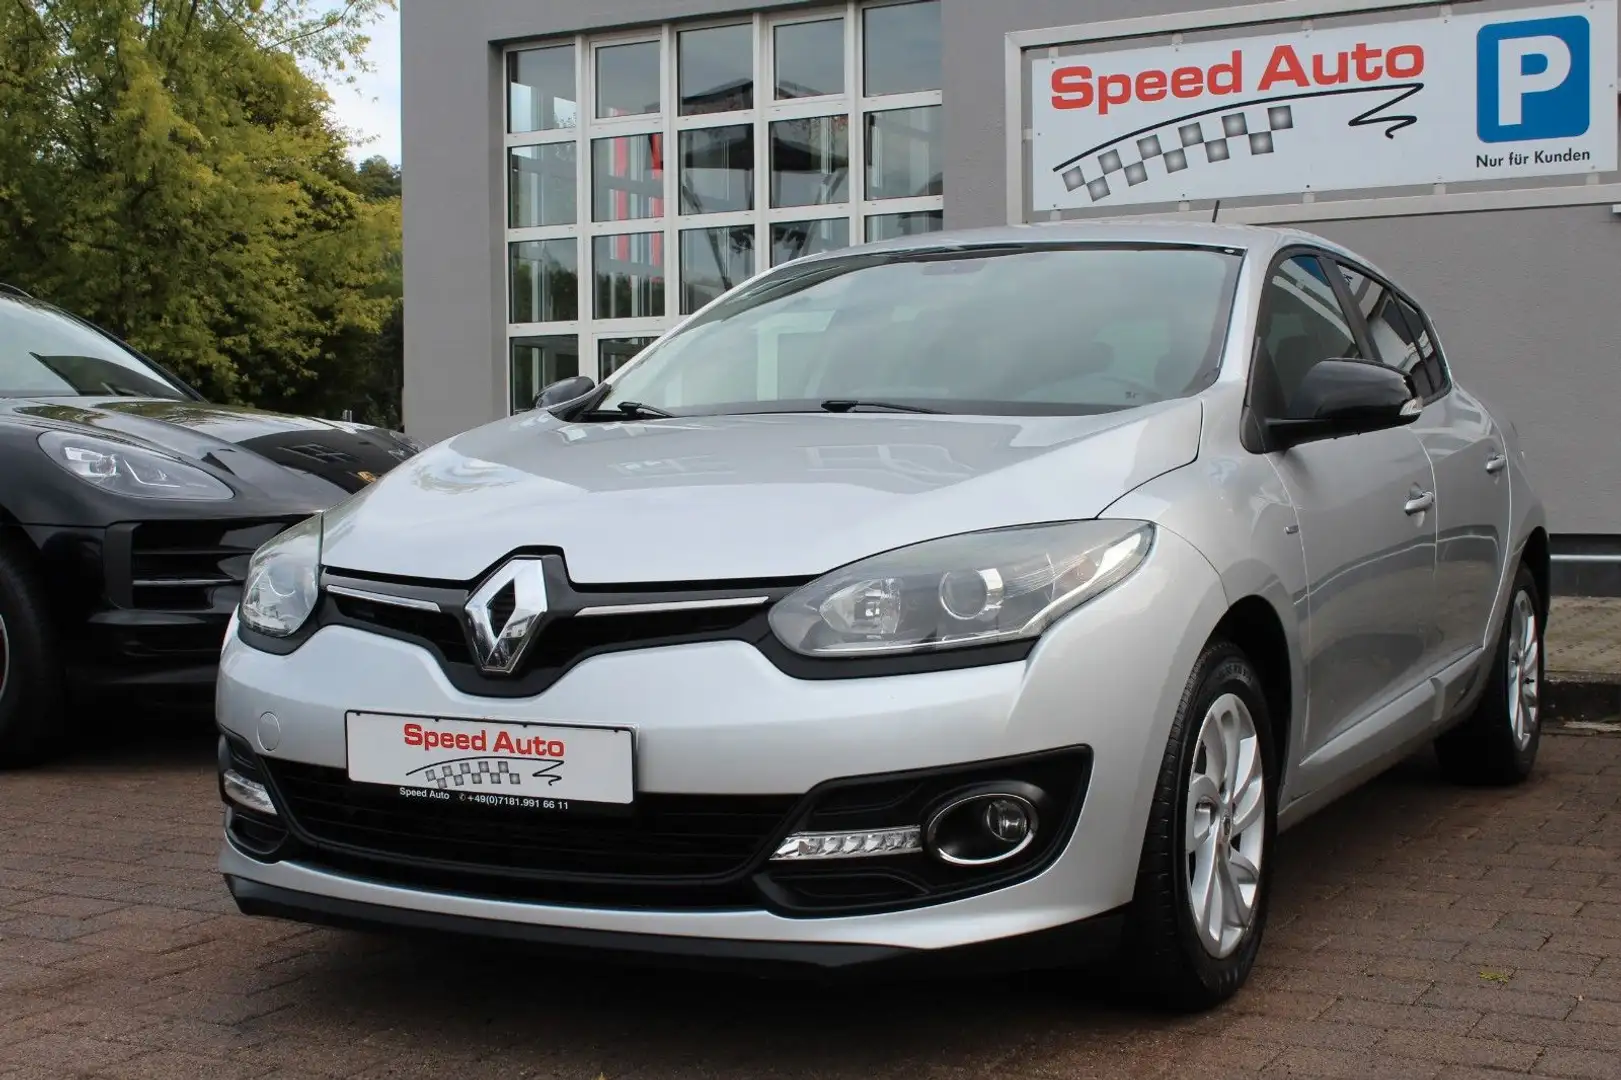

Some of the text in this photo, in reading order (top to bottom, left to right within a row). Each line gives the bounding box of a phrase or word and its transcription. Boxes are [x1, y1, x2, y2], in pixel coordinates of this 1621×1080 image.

[1051, 43, 1425, 115] Speed Auto
[1498, 35, 1572, 126] P
[1476, 147, 1590, 168] Nur für Kunden
[404, 723, 565, 757] Speed Auto
[399, 787, 569, 810] Speed Auto +49(0)7181.991 66 11
